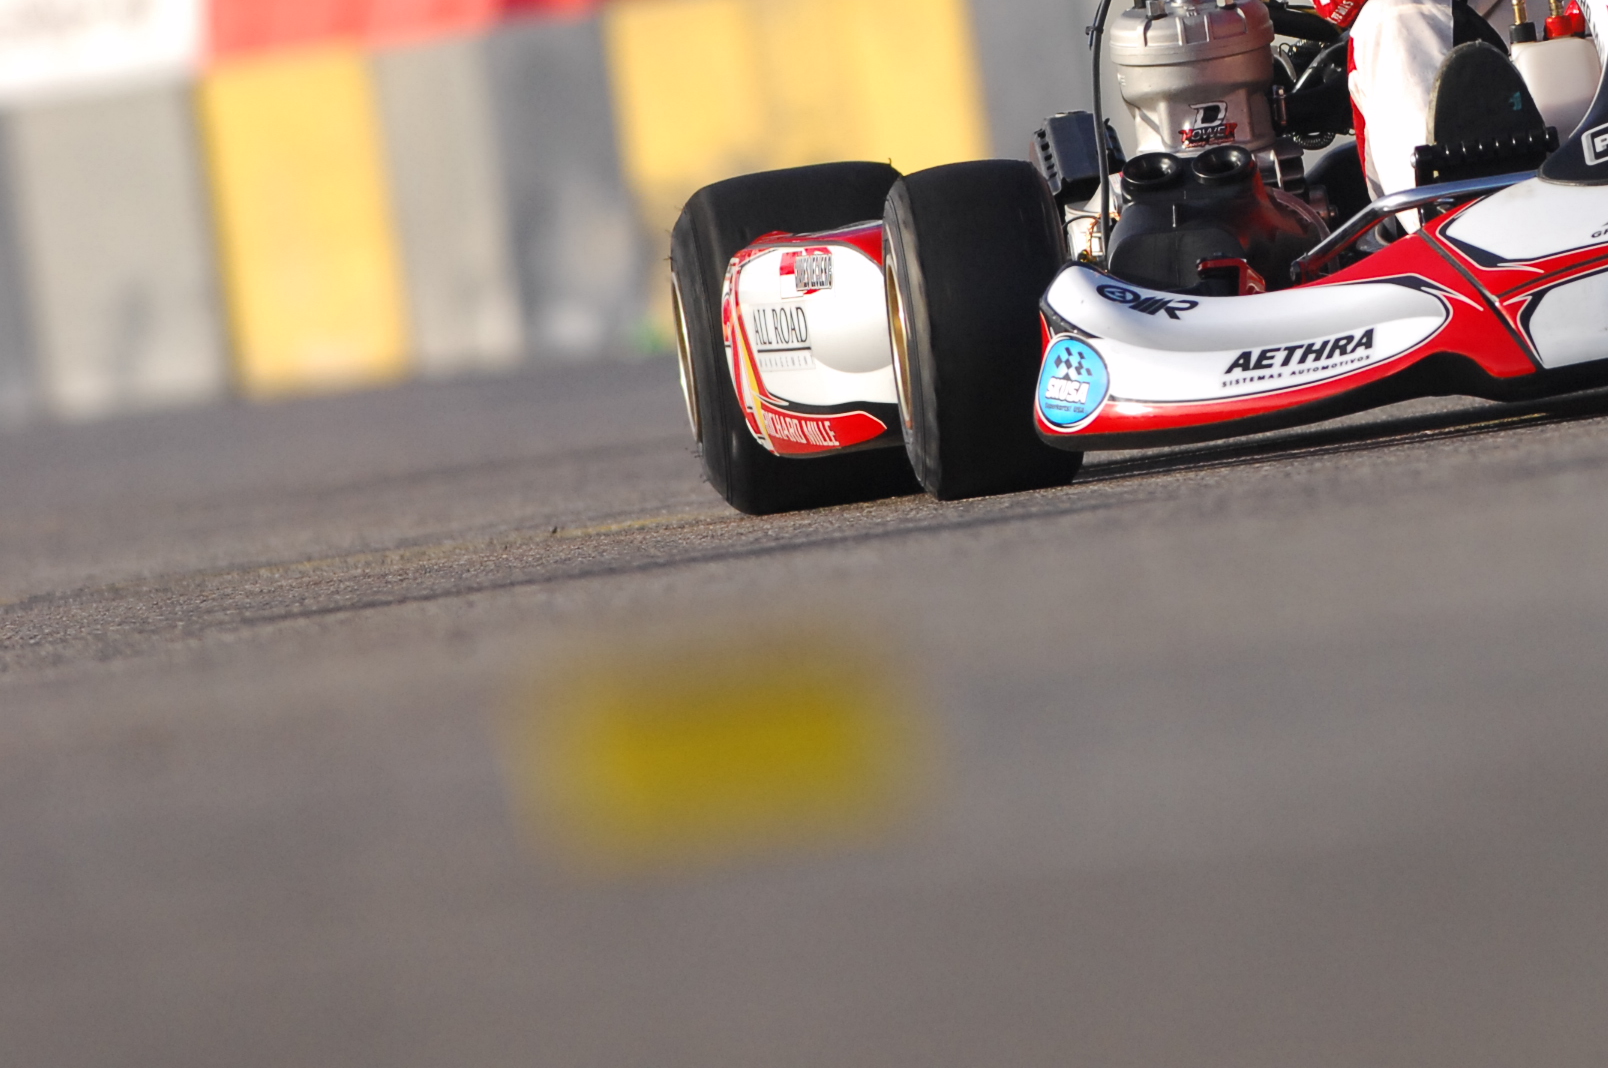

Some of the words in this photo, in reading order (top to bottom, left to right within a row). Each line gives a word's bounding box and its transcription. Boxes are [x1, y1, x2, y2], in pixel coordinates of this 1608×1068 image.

[752, 309, 772, 346] ALL
[773, 306, 808, 344] ROAD
[1224, 328, 1375, 374] AETHRA
[1222, 373, 1283, 387] SISTEMAS
[1290, 355, 1371, 376] AUTOMOTIVOS
[762, 410, 807, 444] RICHARD
[801, 420, 841, 446] MILLE
